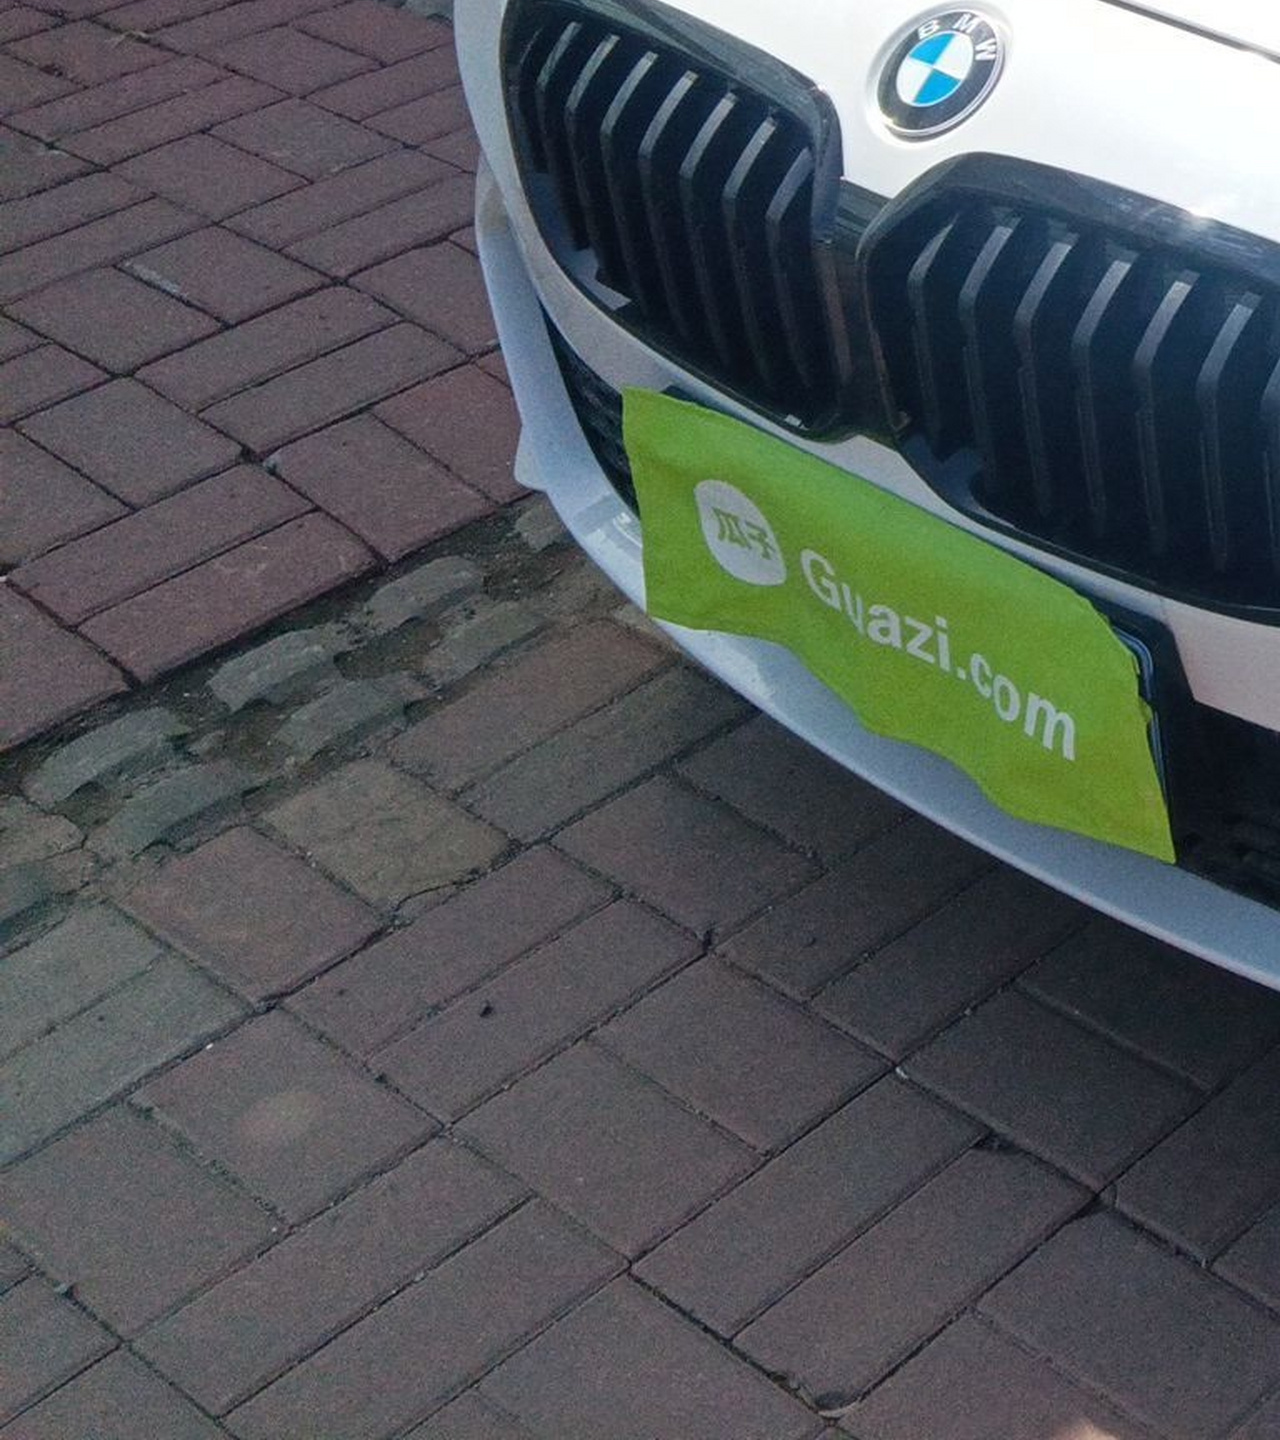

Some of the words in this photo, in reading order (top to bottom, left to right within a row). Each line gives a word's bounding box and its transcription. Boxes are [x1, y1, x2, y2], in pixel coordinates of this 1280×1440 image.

[917, 13, 997, 61] BMW
[712, 507, 778, 562] 瓜子
[800, 548, 1078, 762] Guazi.com
